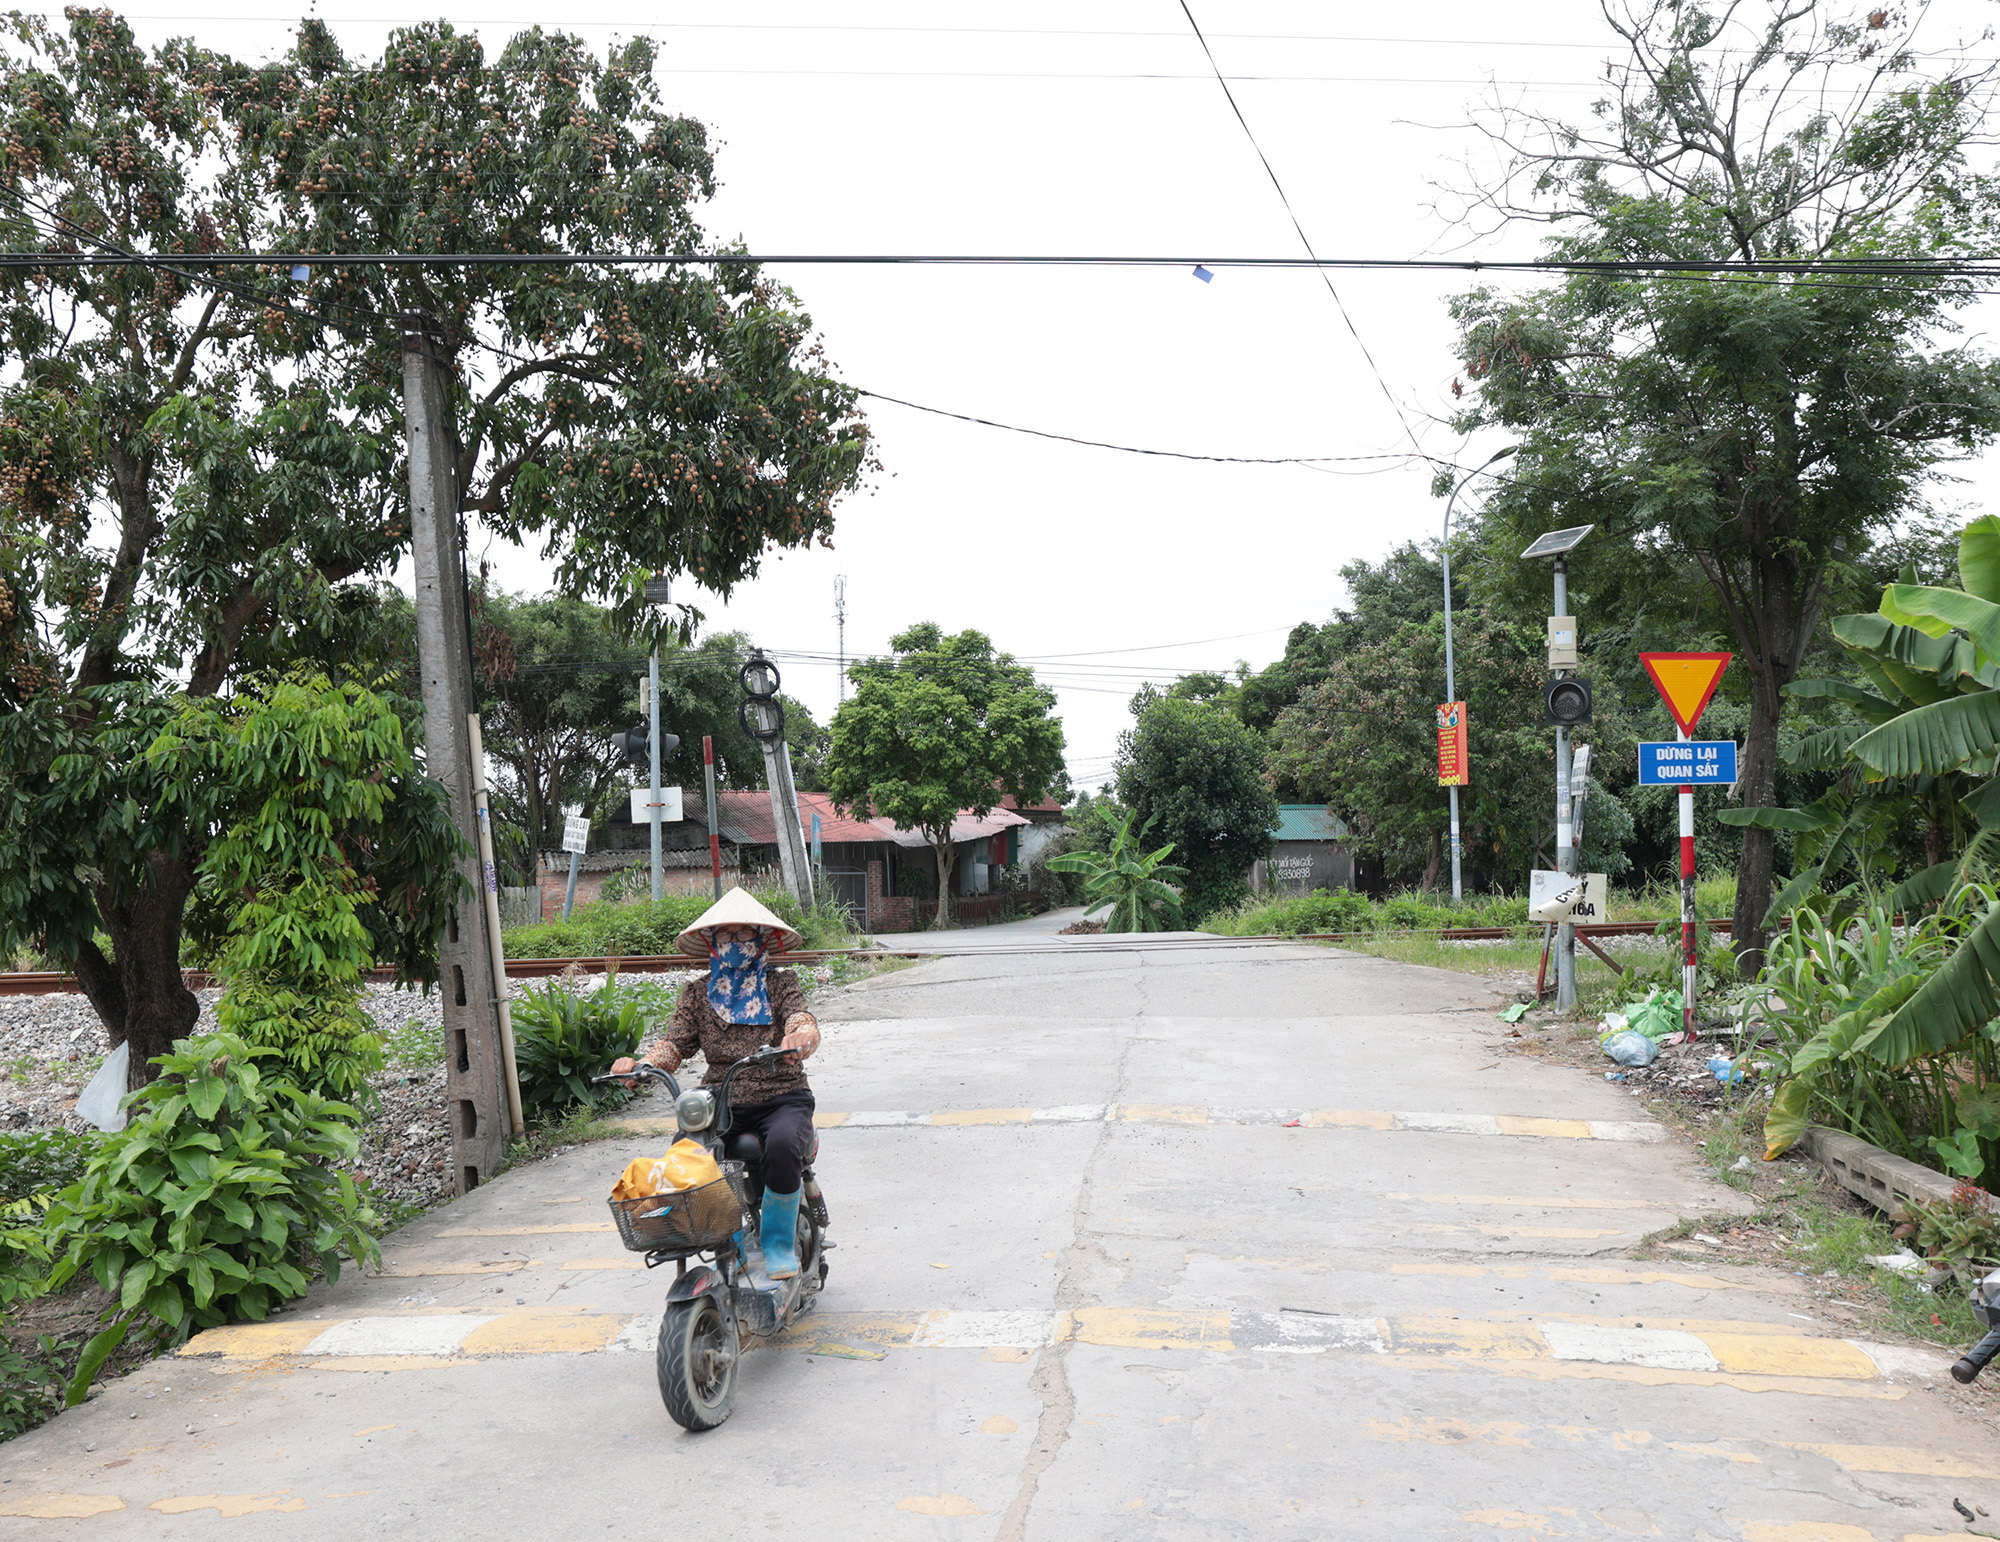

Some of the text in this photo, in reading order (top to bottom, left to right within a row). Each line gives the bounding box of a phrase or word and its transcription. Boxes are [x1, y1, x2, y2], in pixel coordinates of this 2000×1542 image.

[1656, 746, 1717, 762] DỪNG LẠI
[1657, 762, 1719, 779] QUAN SÁT
[1300, 853, 1314, 867] GỐC
